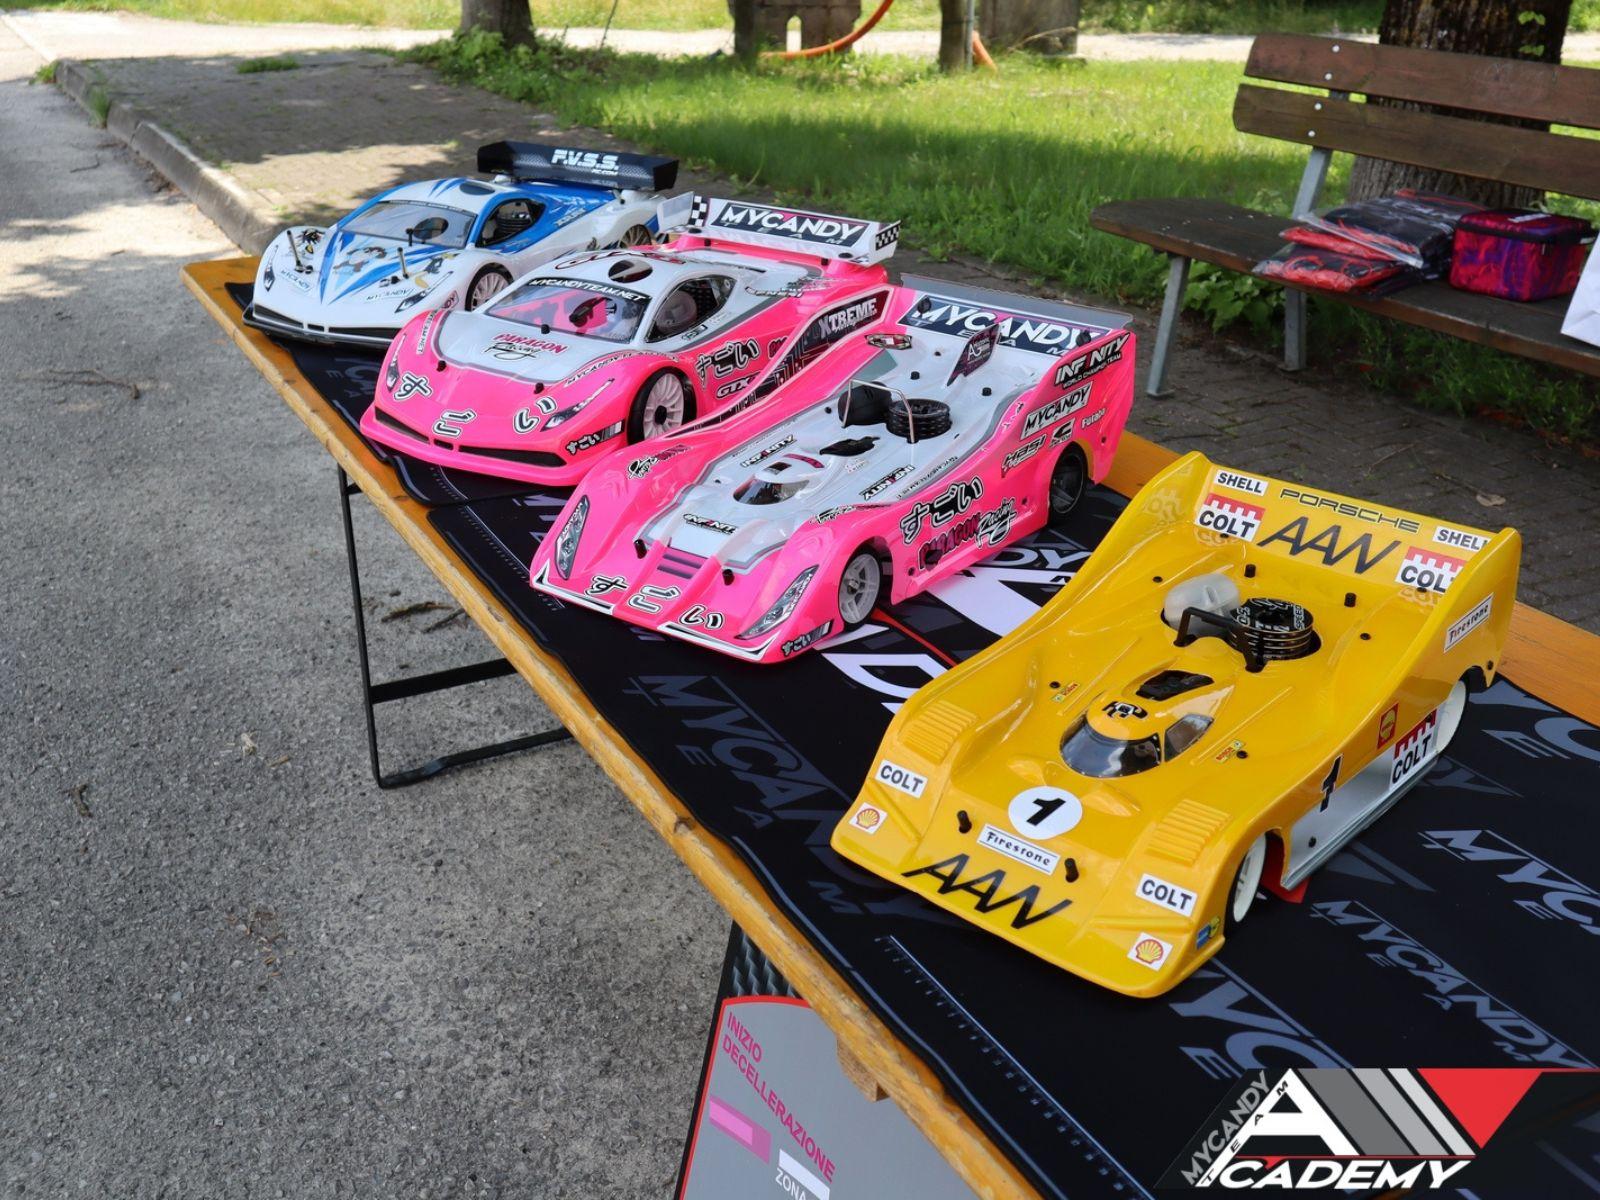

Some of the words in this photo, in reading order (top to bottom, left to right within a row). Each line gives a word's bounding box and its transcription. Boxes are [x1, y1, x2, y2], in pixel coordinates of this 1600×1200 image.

[730, 206, 873, 240] MYCANDY
[529, 279, 646, 302] MYCANDYTEAM.NET
[820, 298, 878, 337] XTREME
[493, 333, 568, 353] PARAGON
[695, 338, 761, 389] すごい
[1024, 385, 1091, 431] MYCANDY
[566, 432, 601, 455] すごい
[1217, 472, 1262, 493] SHELL
[900, 476, 984, 545] すごい
[976, 497, 1018, 549] Racing
[1199, 510, 1256, 539] COLT
[1280, 488, 1421, 533] PORSCHE
[1400, 565, 1454, 593] COL
[585, 575, 724, 631] すごい
[1449, 604, 1489, 643] Firestone
[781, 633, 812, 656] すごい
[880, 764, 923, 793] COLT
[1392, 734, 1432, 784] COLT
[1319, 756, 1343, 812] 1
[1026, 798, 1066, 827] 1
[986, 831, 1051, 867] Firestone
[1141, 879, 1192, 910] COLT
[1313, 900, 1594, 1069] MYCANDY
[727, 1012, 763, 1063] INIZIO
[722, 1035, 836, 1183] DECELLERAZIONE
